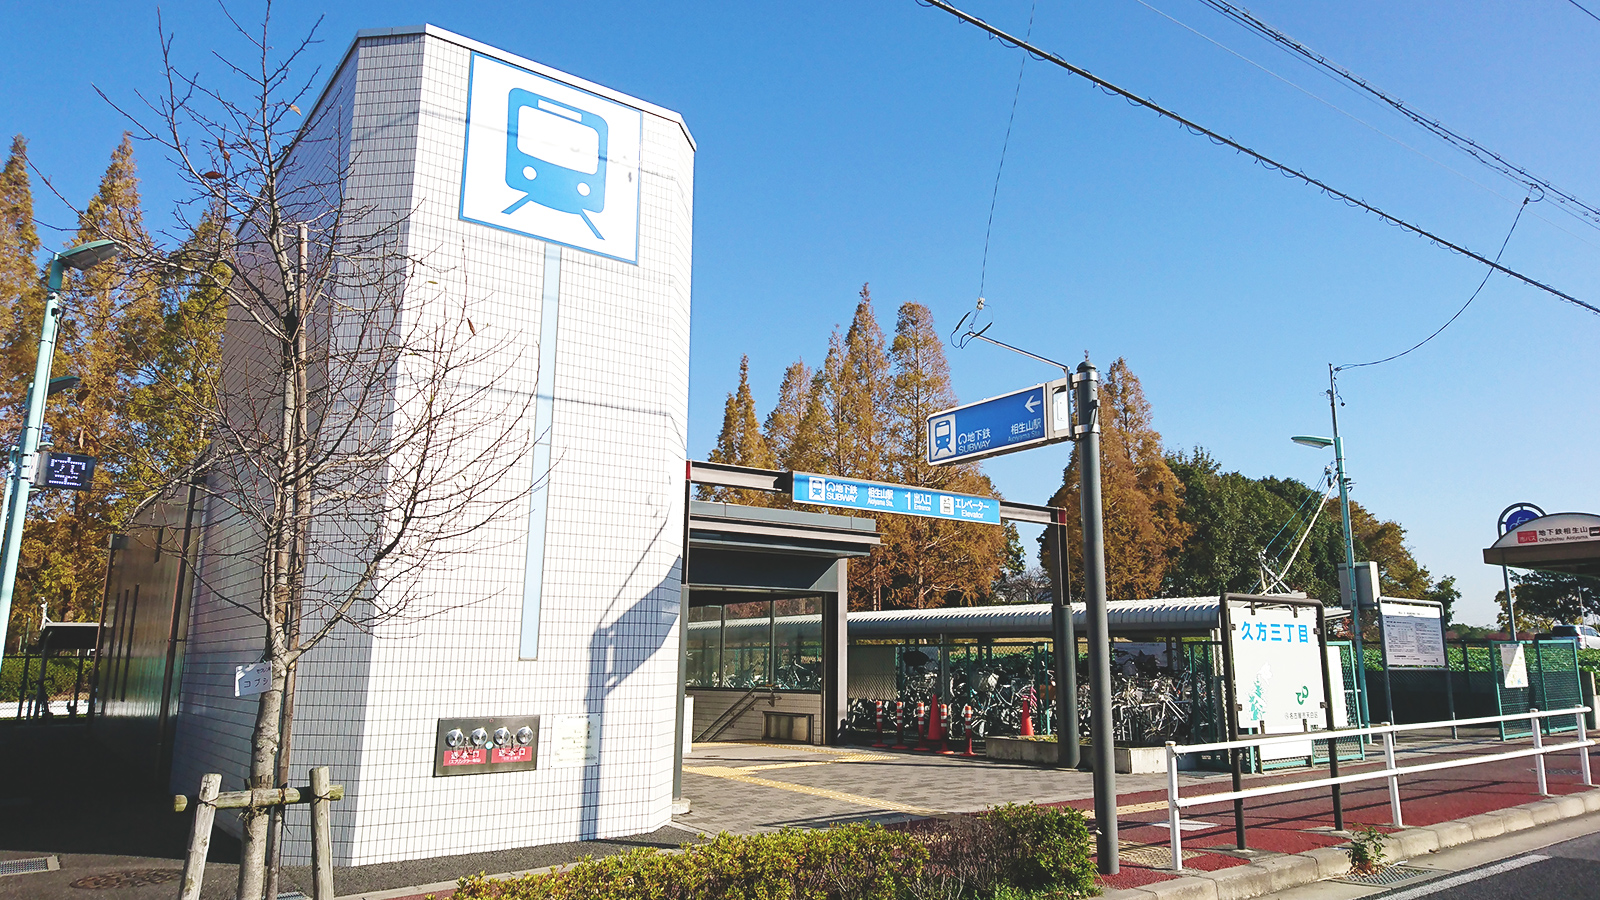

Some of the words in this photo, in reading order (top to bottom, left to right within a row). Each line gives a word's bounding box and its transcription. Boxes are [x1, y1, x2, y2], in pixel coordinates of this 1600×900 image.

[1010, 417, 1042, 435] 相生山駅
[967, 428, 991, 443] 地下鉄
[958, 439, 991, 454] SUBWAY
[835, 484, 858, 496] 地下鉄
[867, 486, 894, 500] 相生山駅
[826, 493, 858, 503] SUBWAY
[905, 492, 911, 511] 1
[914, 493, 932, 505] 出入口
[914, 503, 932, 511] Entrance
[955, 499, 990, 510] エレベーター
[961, 509, 984, 519] Elevator
[1539, 526, 1588, 536] 地下鉄相生山
[1241, 621, 1309, 643] 久方三丁目
[244, 678, 269, 689] コブシ
